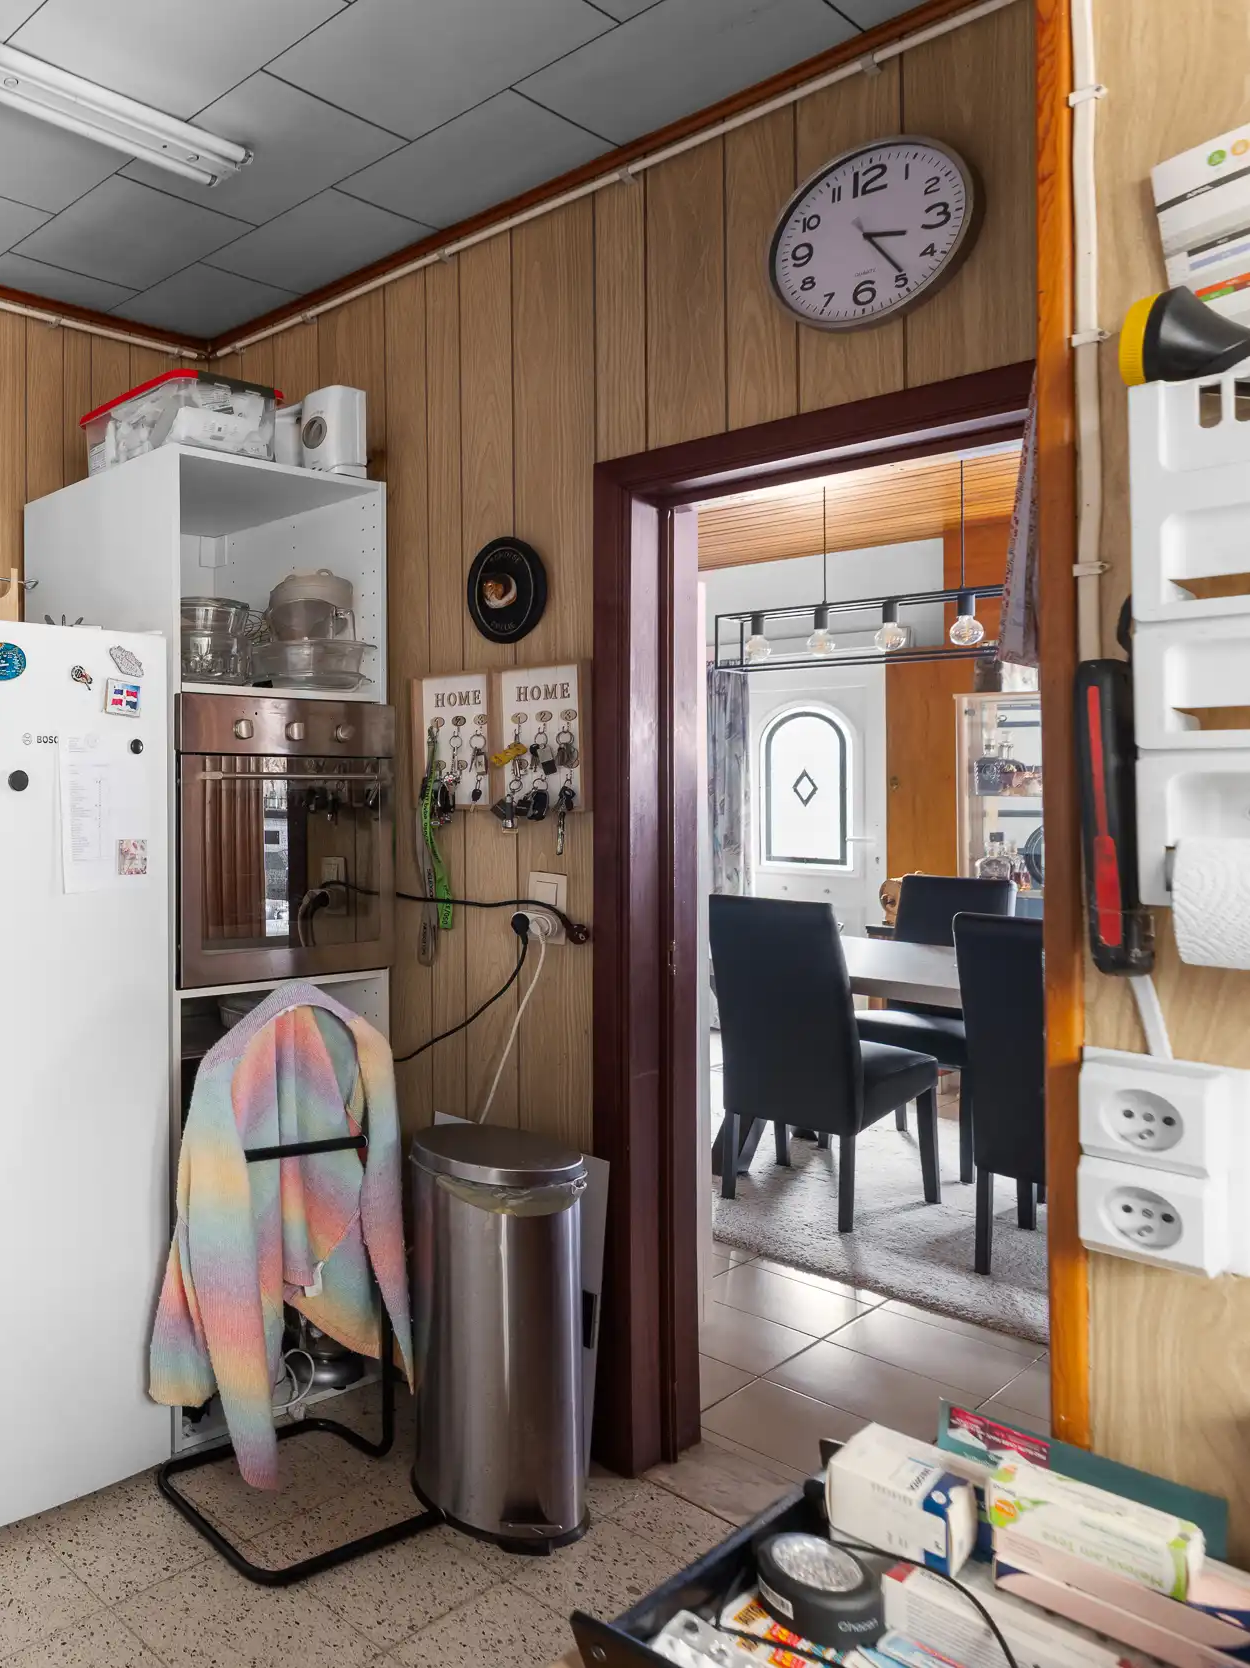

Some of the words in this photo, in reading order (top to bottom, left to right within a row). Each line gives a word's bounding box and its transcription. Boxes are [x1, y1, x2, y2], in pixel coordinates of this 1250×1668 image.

[904, 163, 910, 180] 1
[852, 163, 888, 199] 12
[924, 176, 941, 195] 2
[831, 186, 842, 203] 11
[802, 214, 821, 233] 10
[921, 201, 951, 229] 3
[791, 242, 814, 268] 9
[919, 242, 937, 257] 4
[800, 276, 816, 291] 8
[894, 273, 908, 288] 5
[823, 292, 835, 308] 7
[852, 280, 876, 306] 6
[434, 689, 482, 708] HOME
[515, 682, 570, 702] HOME
[540, 711, 546, 721] 2
[565, 709, 571, 720] 3
[36, 735, 59, 744] BOSC
